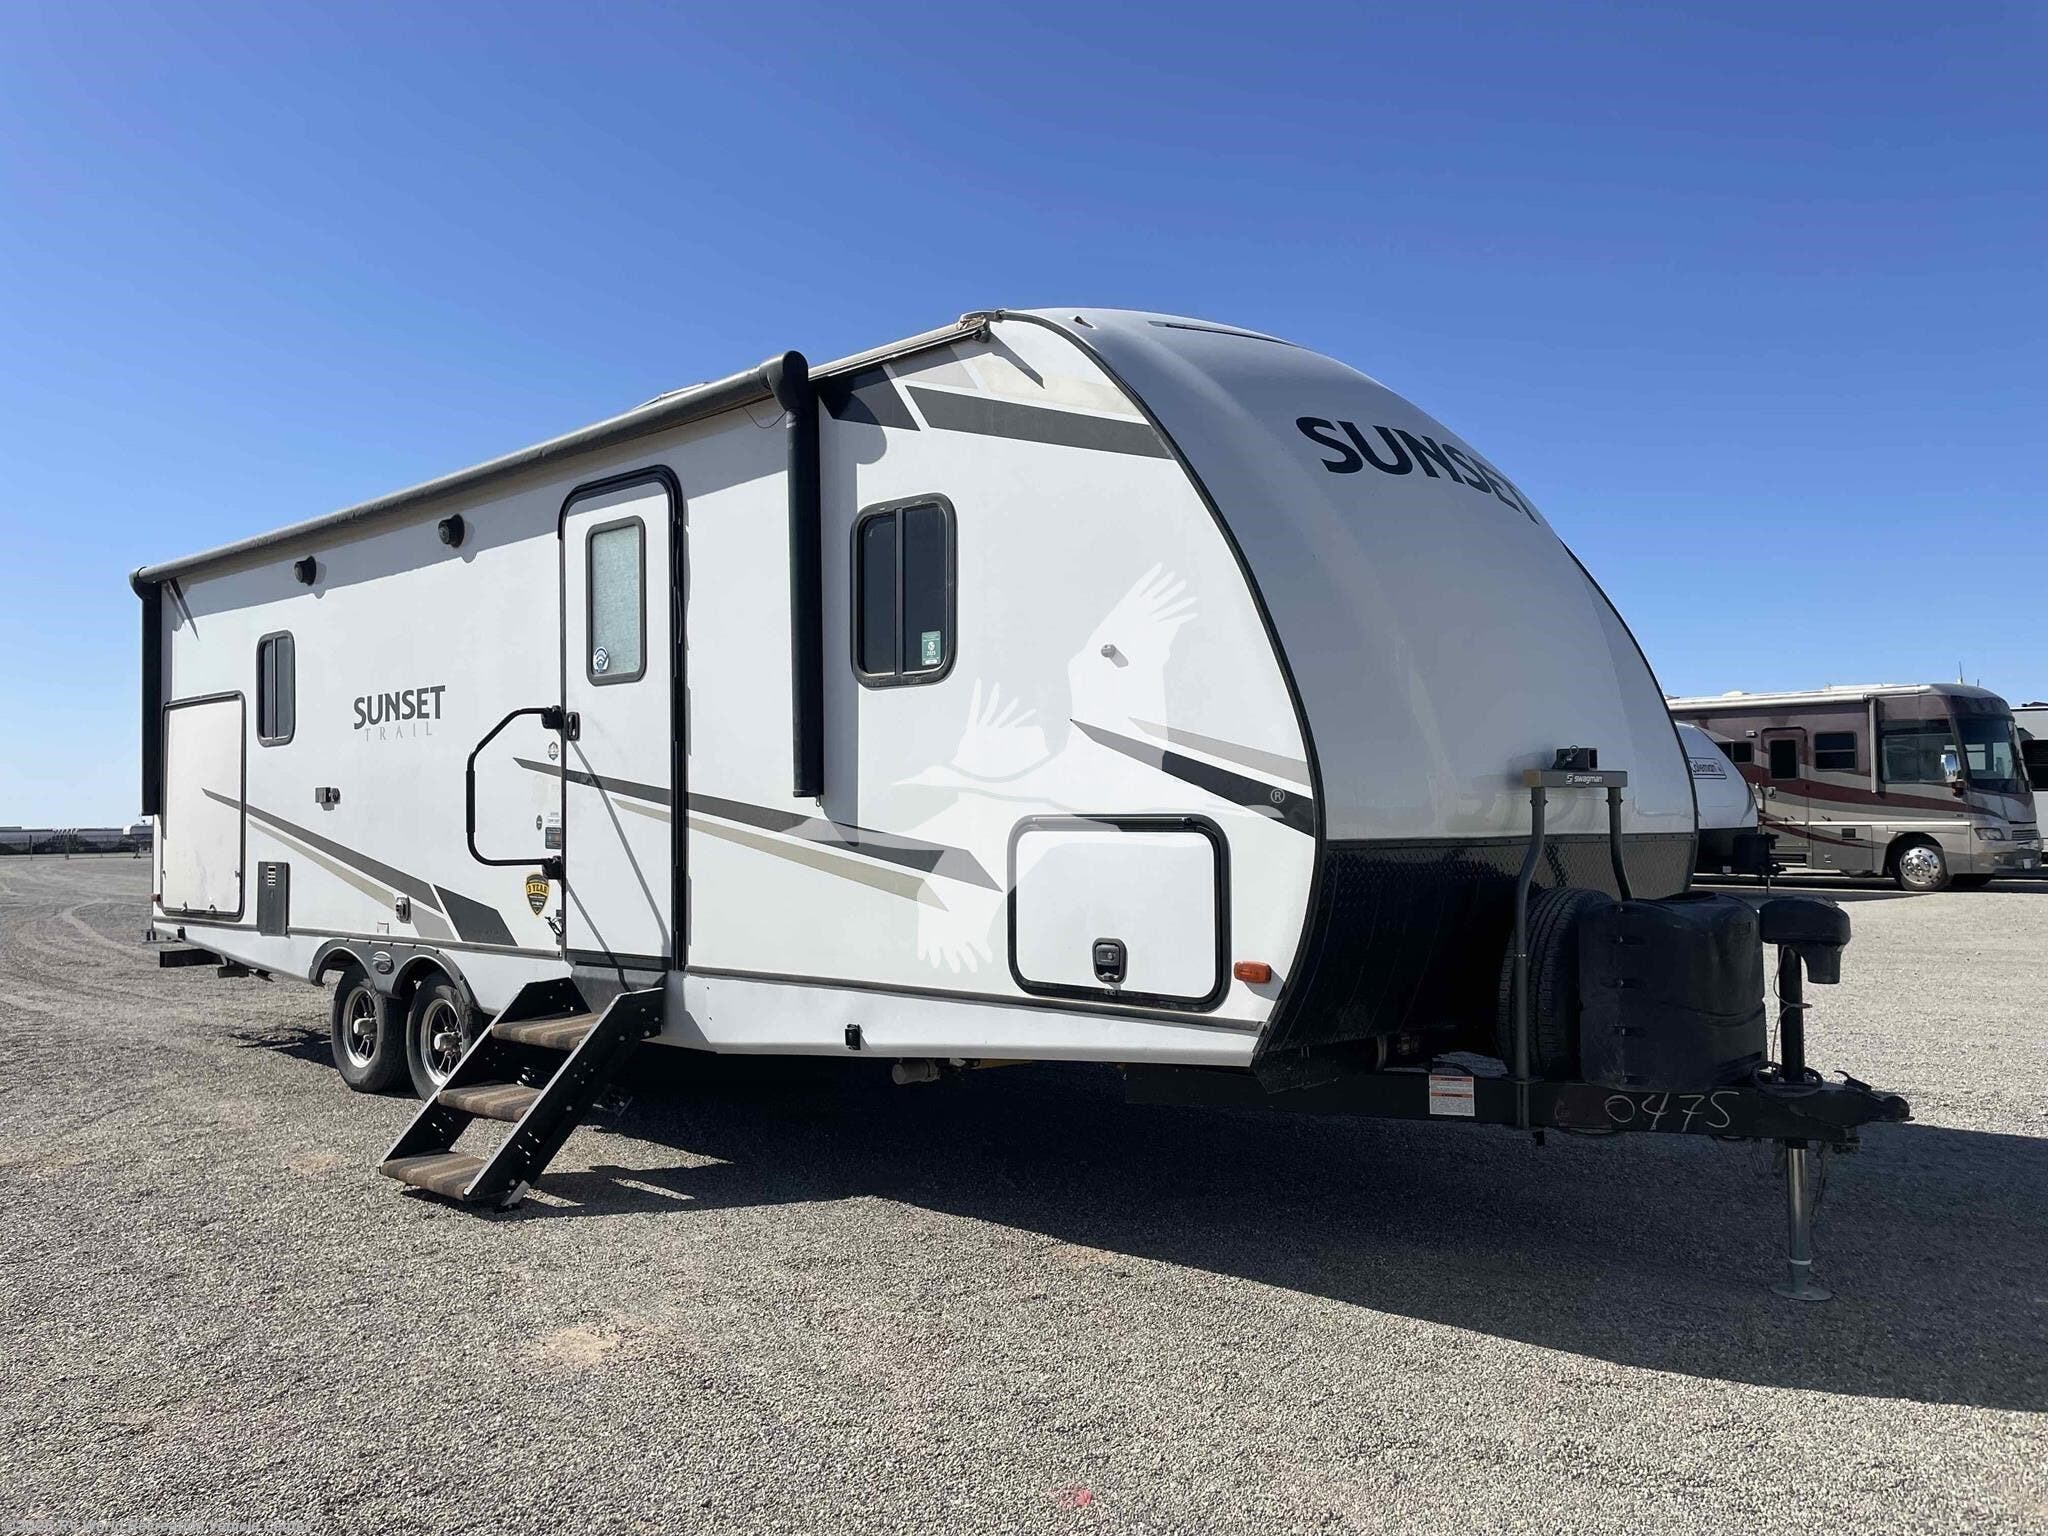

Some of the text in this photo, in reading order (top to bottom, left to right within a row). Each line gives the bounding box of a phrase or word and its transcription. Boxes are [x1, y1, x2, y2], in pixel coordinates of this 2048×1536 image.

[1295, 416, 1540, 525] SUNSET
[353, 684, 446, 730] SUNSET
[364, 721, 433, 742] TRAIL
